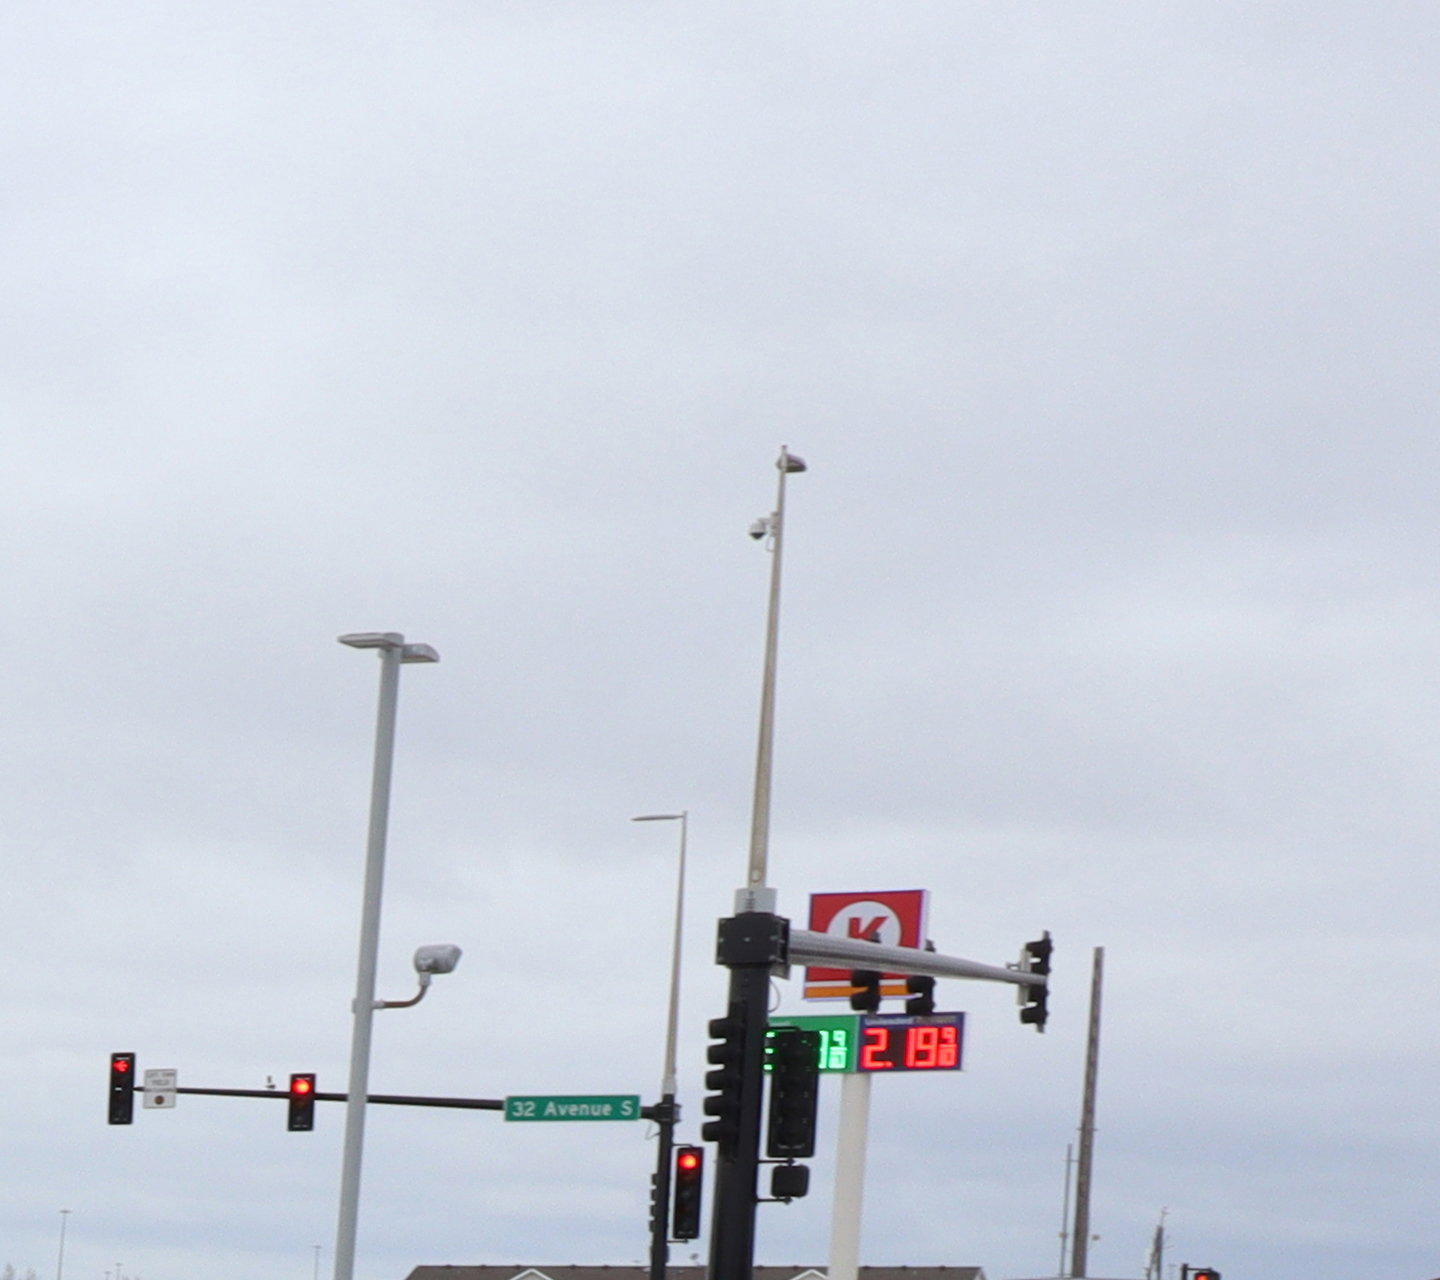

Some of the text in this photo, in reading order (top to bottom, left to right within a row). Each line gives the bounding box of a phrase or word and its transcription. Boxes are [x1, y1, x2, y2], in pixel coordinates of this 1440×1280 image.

[512, 1100, 634, 1117] 32 Avenue S
